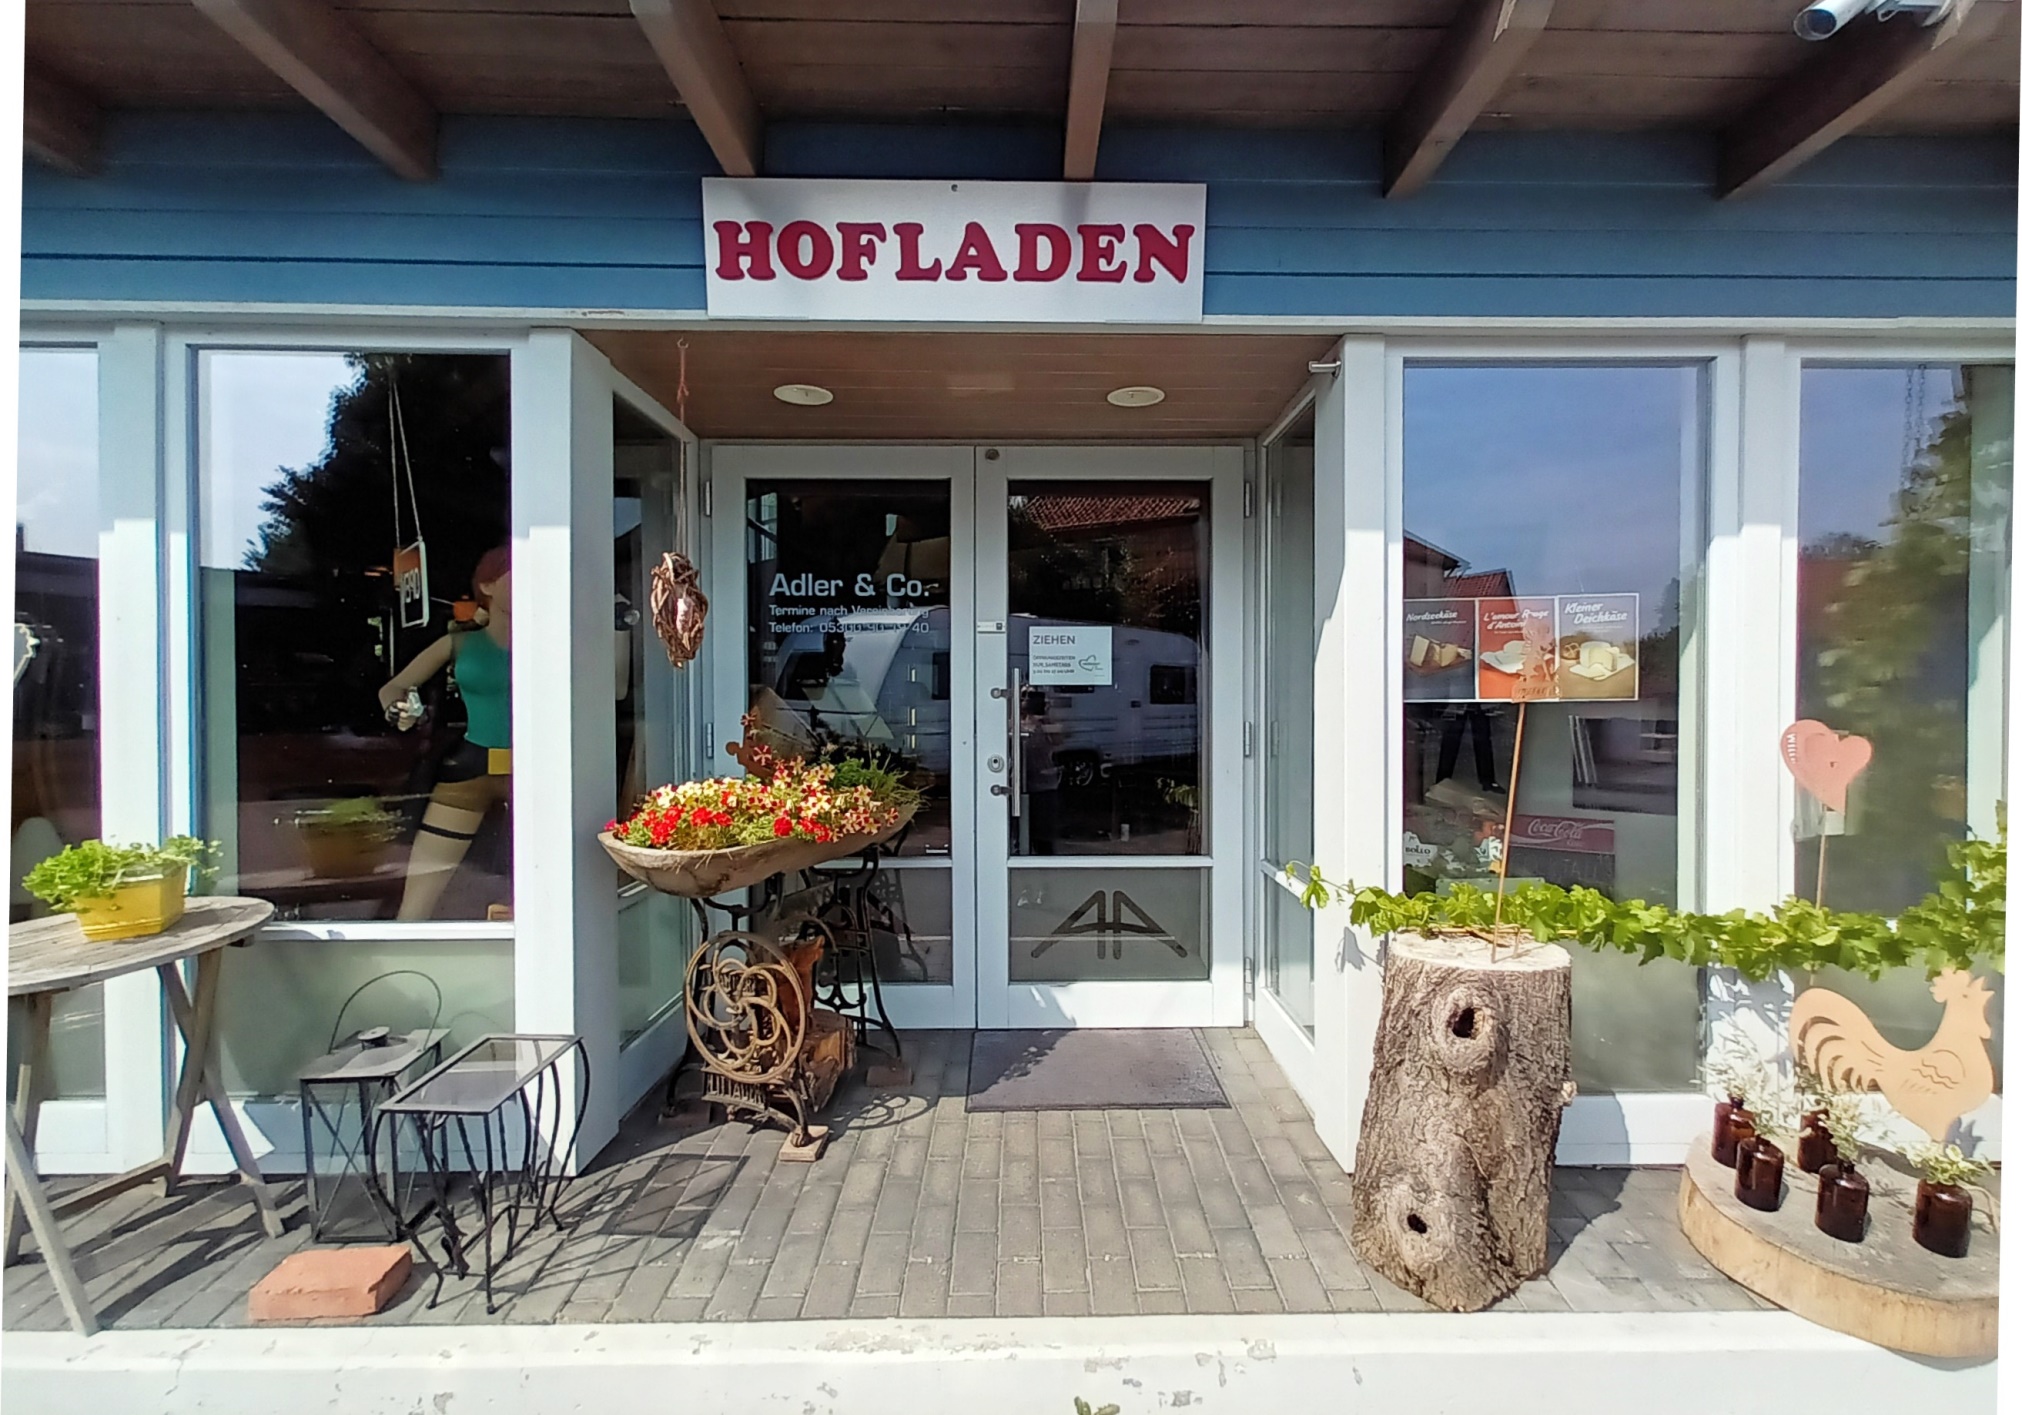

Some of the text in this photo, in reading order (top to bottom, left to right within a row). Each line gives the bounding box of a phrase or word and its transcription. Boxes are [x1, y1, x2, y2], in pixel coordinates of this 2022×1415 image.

[712, 220, 1196, 283] HOFLADEN
[769, 573, 930, 597] Adler & Co.
[769, 604, 816, 616] Termine
[820, 604, 848, 616] nach
[1564, 602, 1603, 614] Kleiner
[1406, 610, 1458, 622] Nordseekäse
[1574, 611, 1628, 625] Deichkäse
[769, 622, 813, 633] Telefon:
[911, 622, 930, 633] 40
[1033, 635, 1076, 645] ZIEHEN
